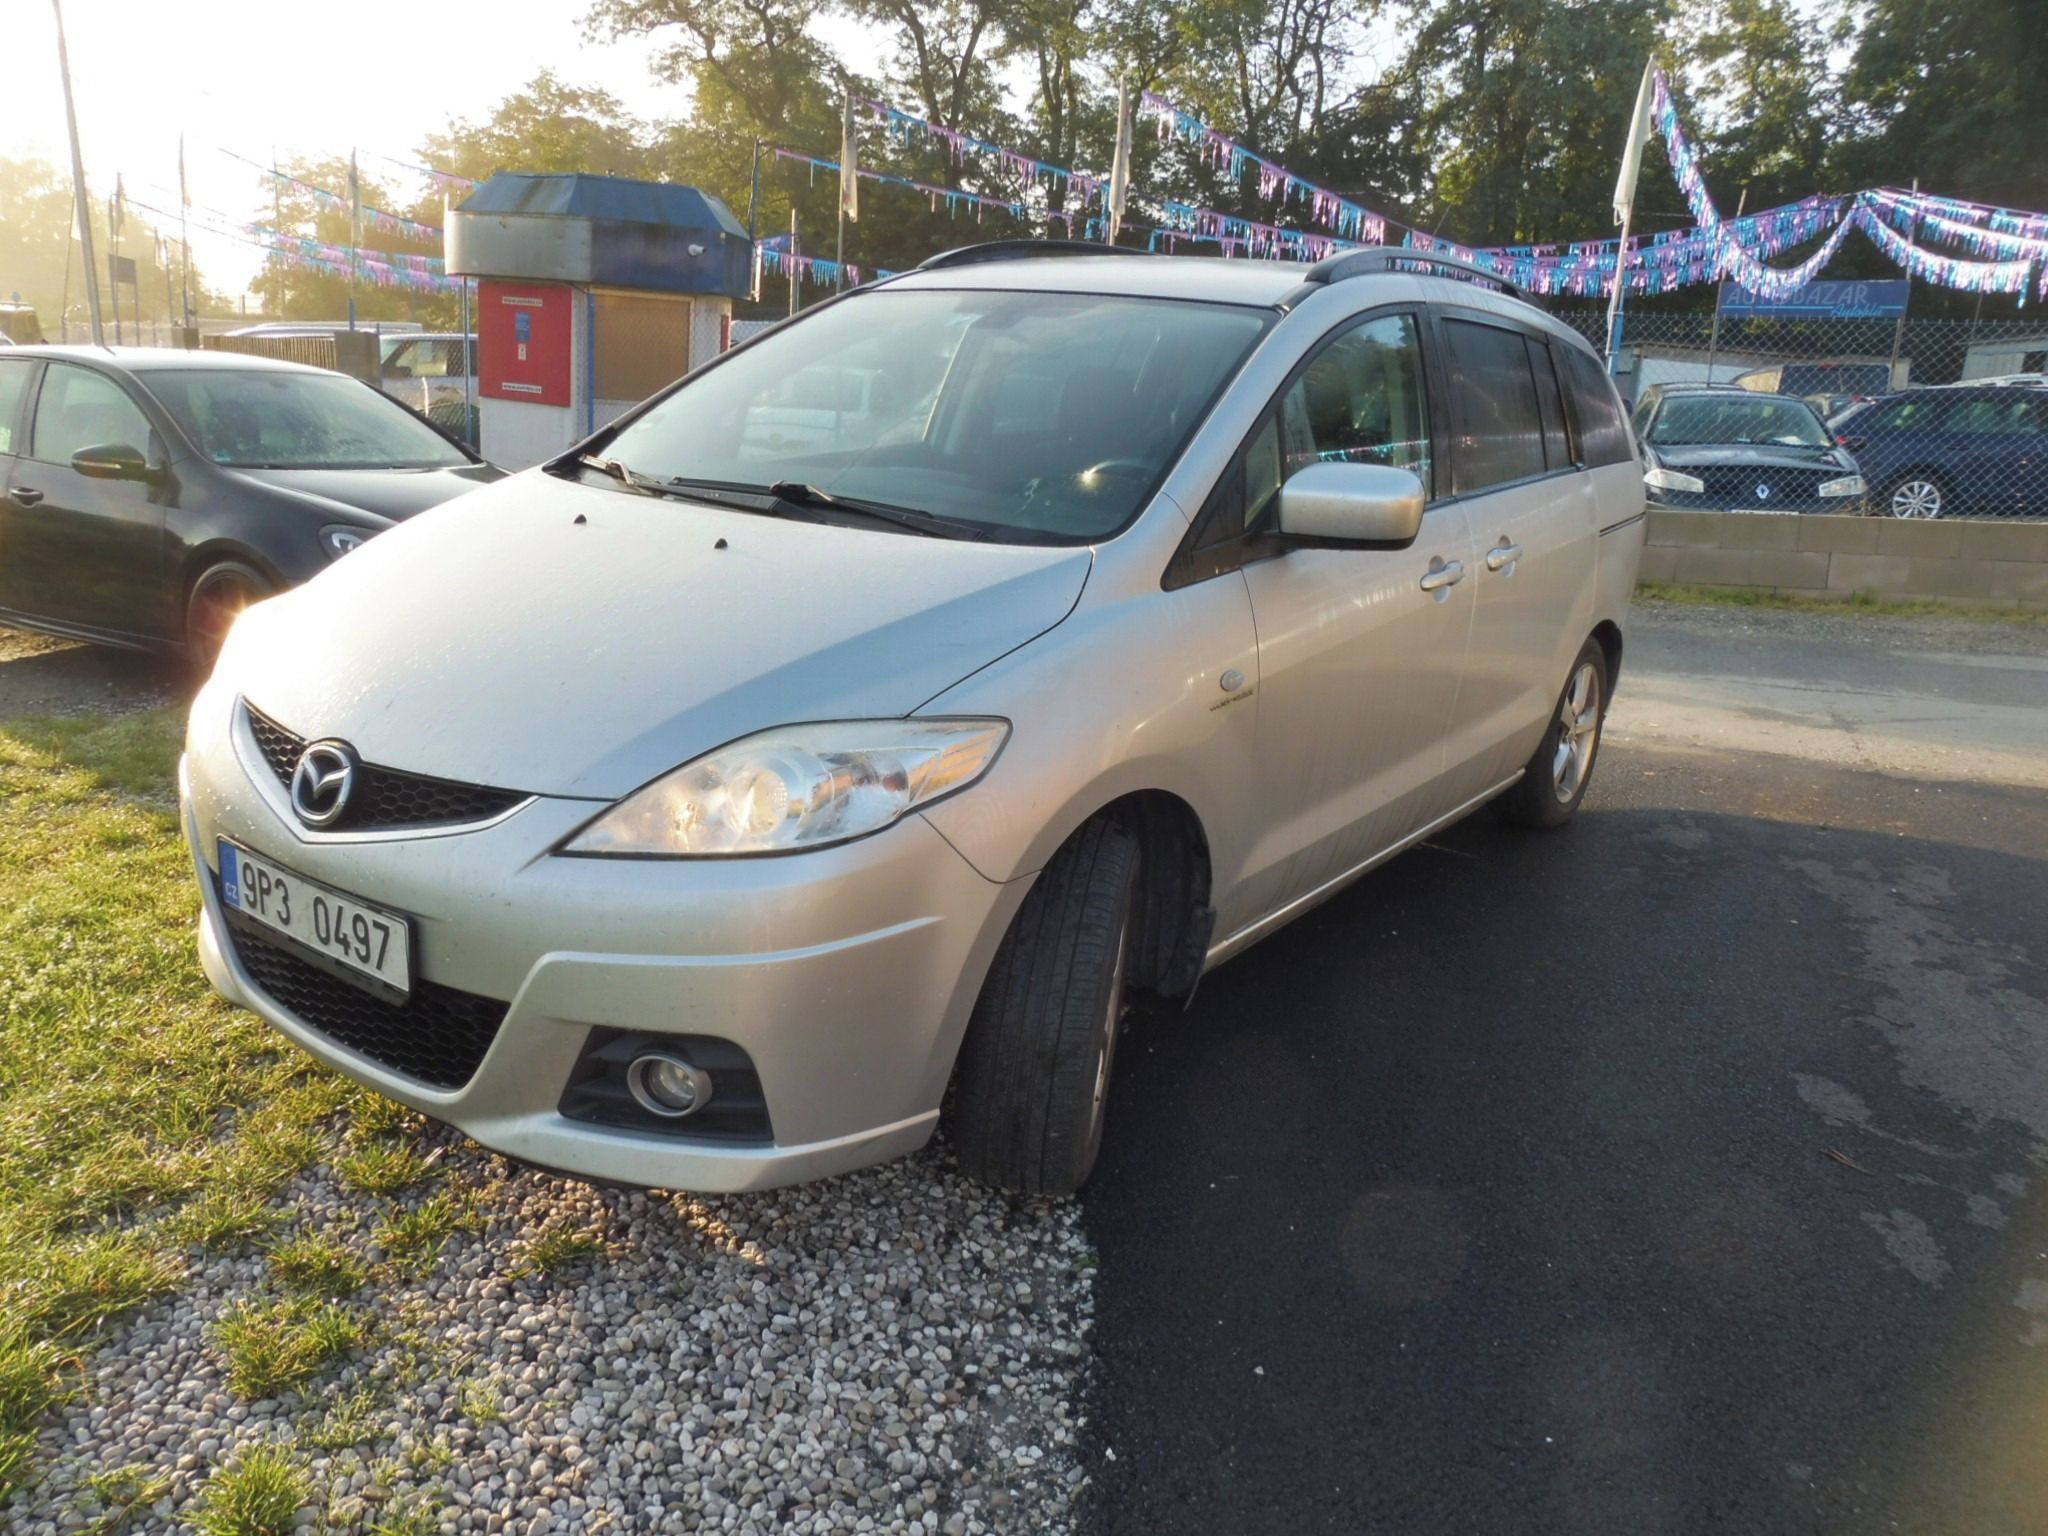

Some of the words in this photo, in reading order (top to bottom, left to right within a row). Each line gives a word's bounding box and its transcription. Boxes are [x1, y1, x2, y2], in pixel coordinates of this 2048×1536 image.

[1726, 284, 1869, 305] AUBAZAR
[225, 882, 238, 899] CZ
[242, 861, 291, 926] 9P3
[313, 896, 390, 971] 0497
